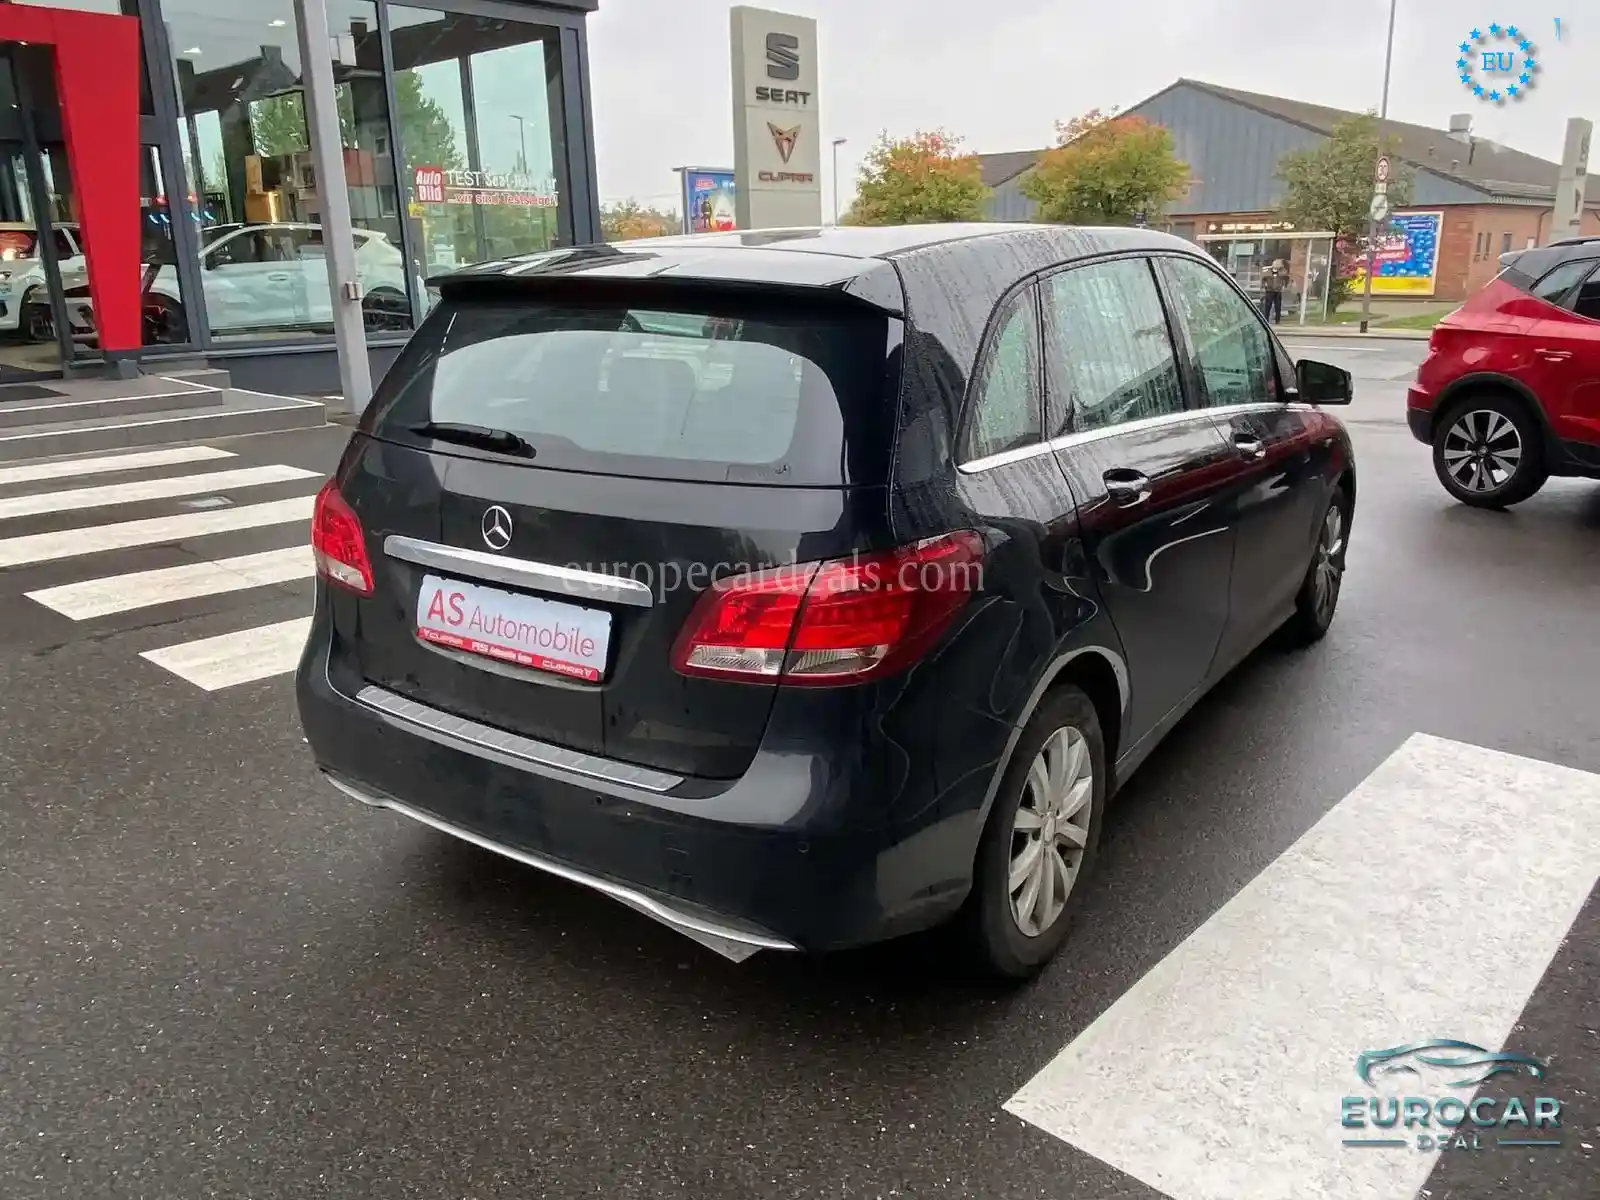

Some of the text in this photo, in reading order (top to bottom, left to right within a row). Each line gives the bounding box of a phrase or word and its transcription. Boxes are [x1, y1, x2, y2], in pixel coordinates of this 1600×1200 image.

[756, 86, 811, 105] SEAT
[416, 170, 441, 186] Auto
[448, 170, 482, 187] TEST
[758, 170, 814, 183] CUPRA
[426, 588, 466, 627] AS
[468, 605, 596, 658] Automobile
